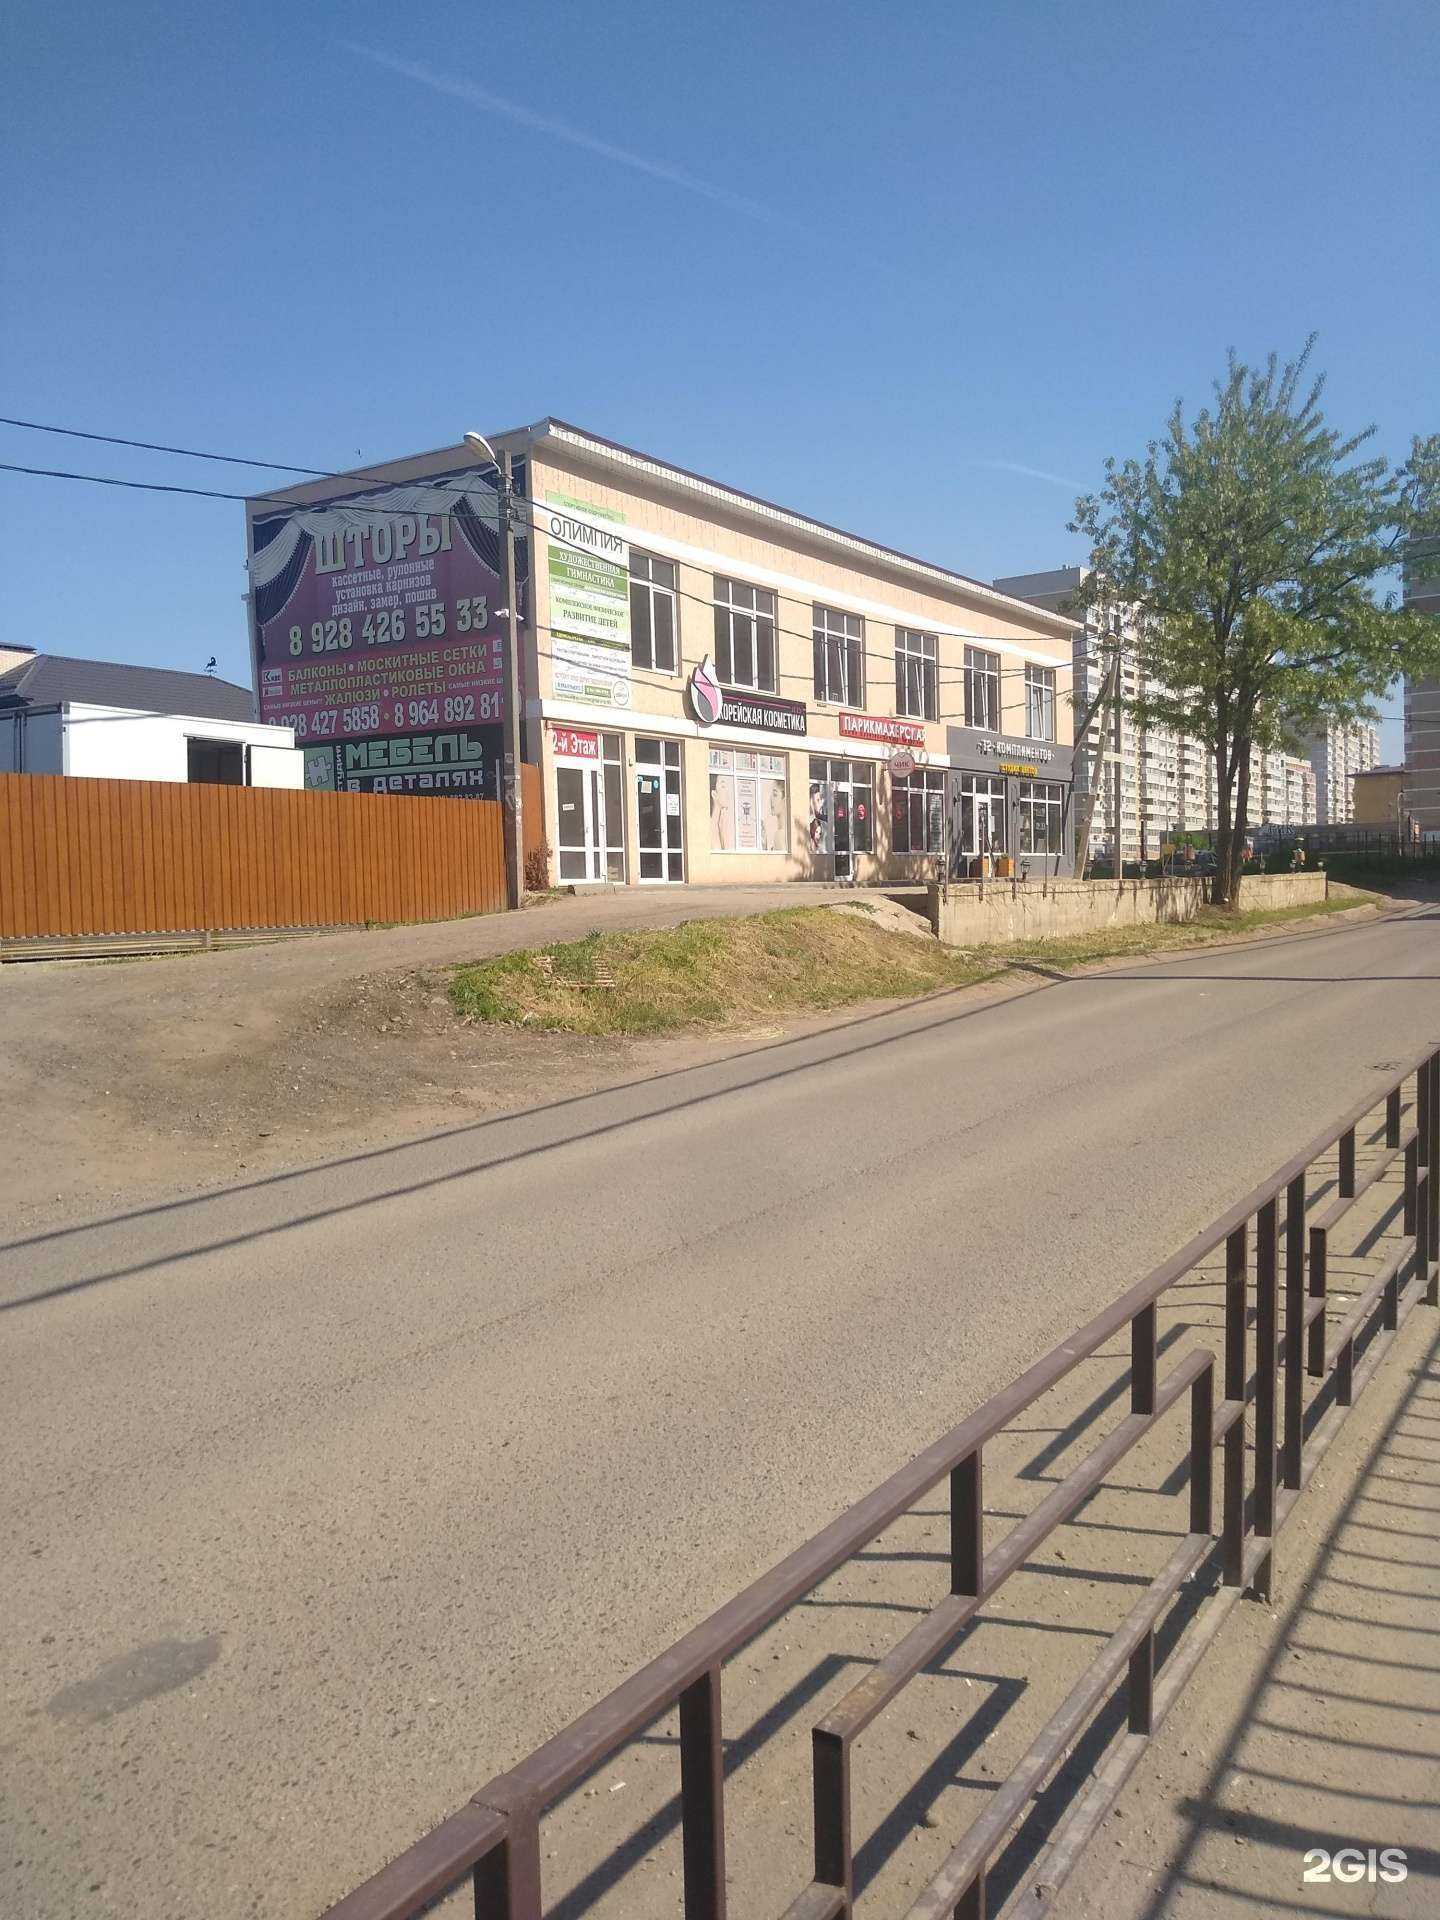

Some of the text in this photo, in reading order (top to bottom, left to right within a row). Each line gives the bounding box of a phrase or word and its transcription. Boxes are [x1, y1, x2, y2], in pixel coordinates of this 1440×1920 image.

[313, 514, 452, 575] ШТОРЫ
[550, 517, 623, 554] ОЛИМПИЯ
[387, 559, 435, 580] рулонные
[559, 552, 621, 575] ХУДОЖЕСТВЕННАЯ
[336, 575, 431, 603] установка карнизов
[566, 568, 615, 588] ГИМНАСТИКА
[405, 588, 437, 603] пошив
[289, 596, 488, 655] 8 928 426 55 33
[563, 609, 618, 629] РАЗВИТИЕ ДЕТЕЙ
[288, 663, 346, 682] БАЛКОНЫ
[357, 652, 439, 672] МОСКИТНЫЕ
[443, 644, 487, 661] СЕТКИ
[291, 666, 444, 696] МЕТАЛЛОПЛАСТИКОВЫЕ
[448, 660, 486, 676] ОКНА
[324, 681, 446, 706] ЖАЛЮЗИ РОЛЕТЫ
[311, 710, 338, 735] 427
[343, 704, 379, 733] 5858
[394, 703, 403, 728] 8
[408, 699, 439, 727] 964
[444, 695, 475, 722] 892
[480, 691, 500, 719] 81
[719, 702, 762, 726] КОРЕЙСКАЯ
[763, 709, 806, 731] КОСМЕТИКА
[844, 716, 926, 741] ПАРИКМАХЕРСКАЯ
[346, 733, 483, 769] МЕБЕЛЬ
[552, 731, 596, 755] 2-й Этаж
